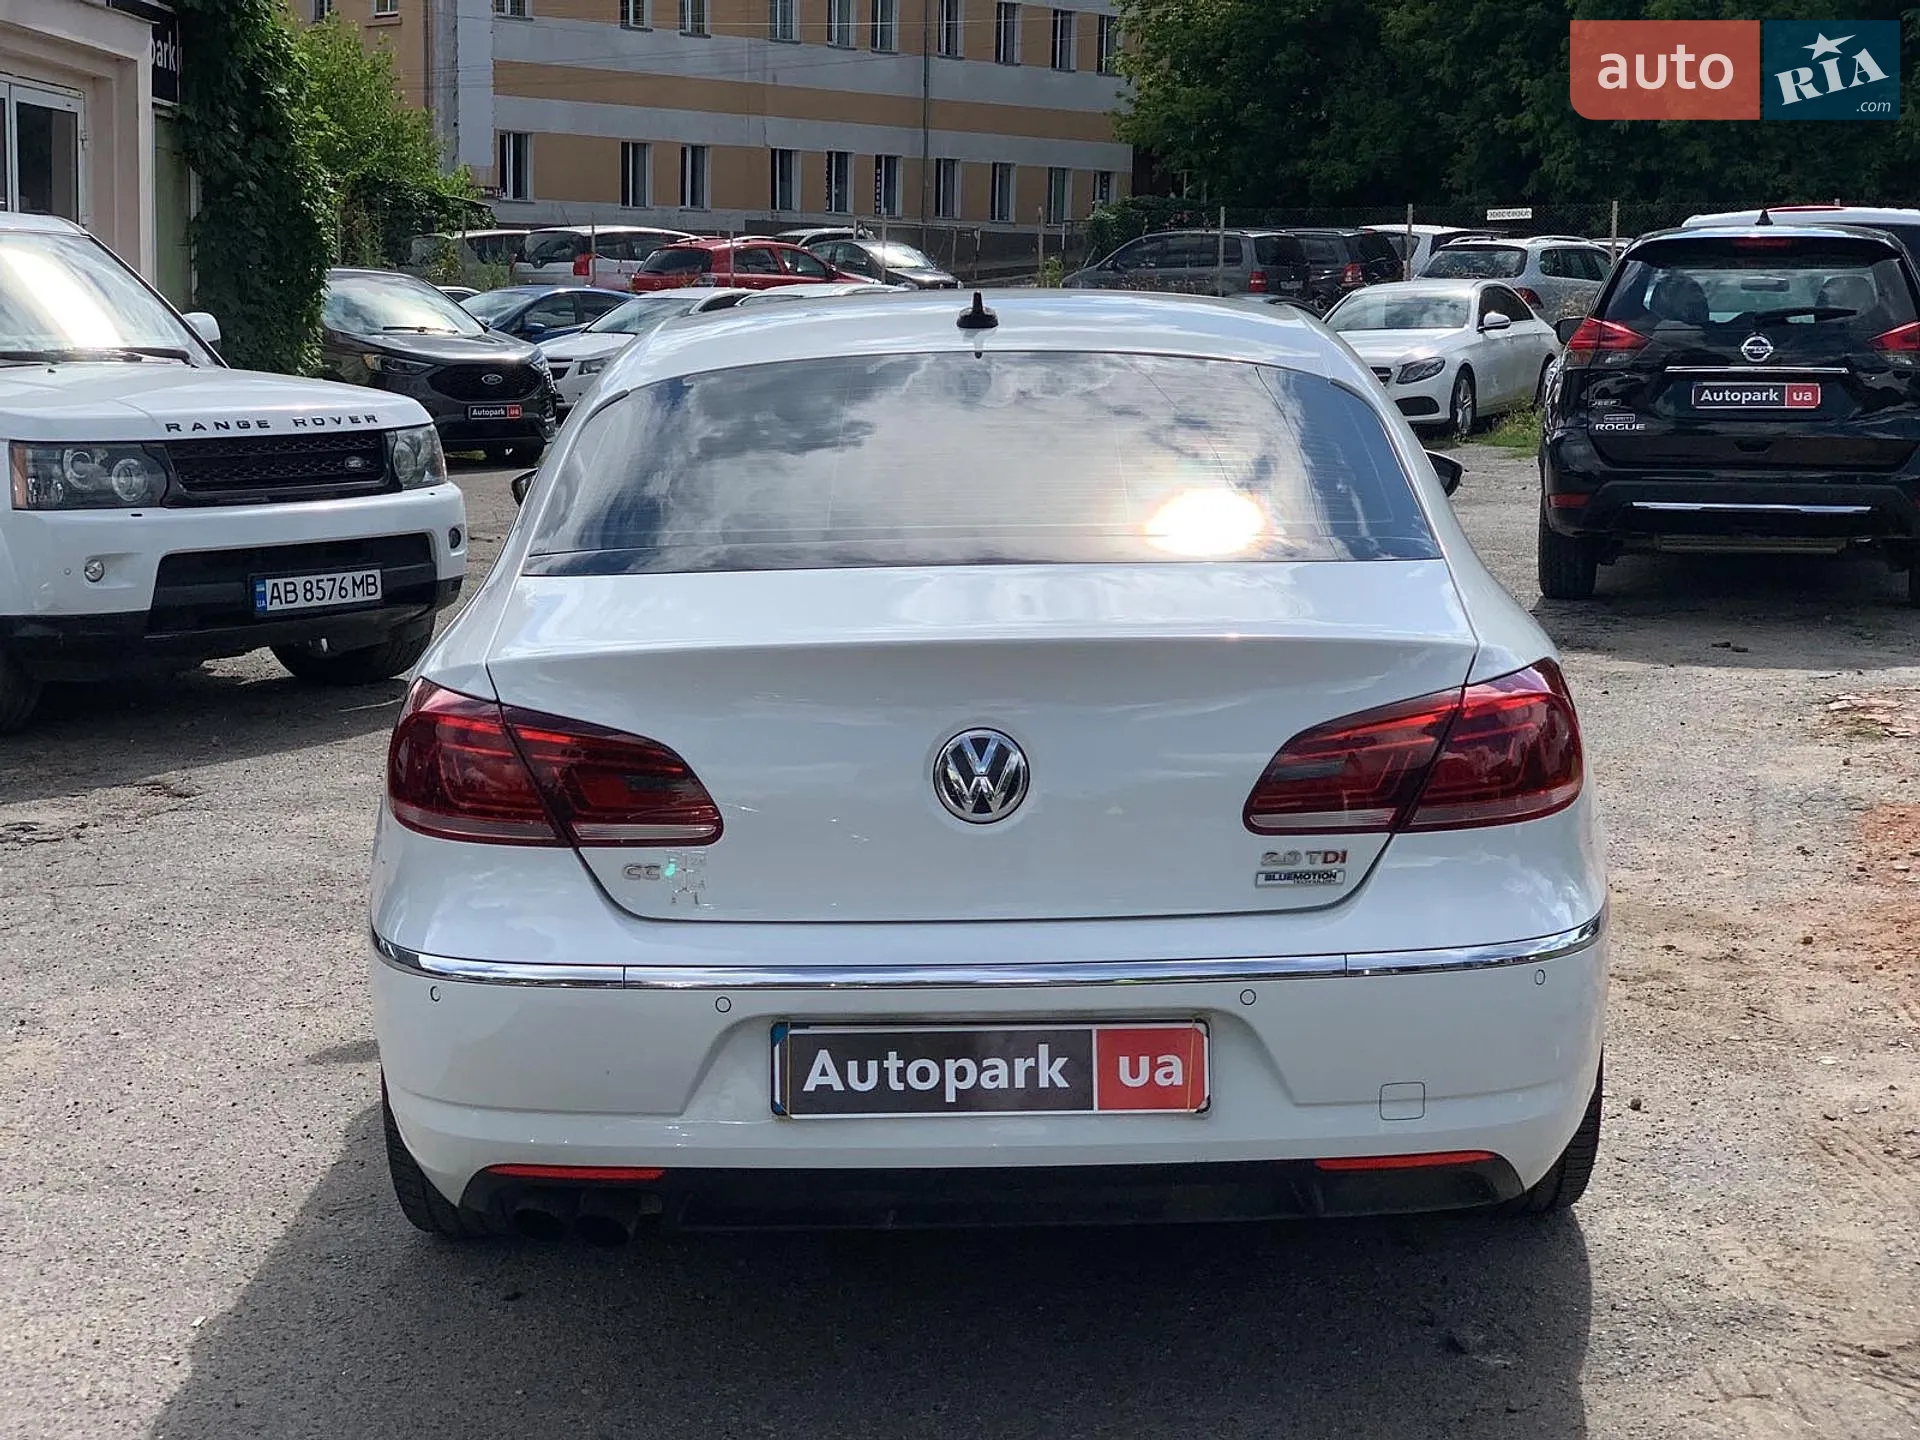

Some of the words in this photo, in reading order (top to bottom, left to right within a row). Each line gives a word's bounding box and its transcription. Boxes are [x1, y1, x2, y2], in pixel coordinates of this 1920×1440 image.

[1700, 388, 1779, 405] Autopark
[1792, 391, 1812, 401] ua
[472, 407, 506, 417] Autopark
[165, 419, 271, 433] RANGE
[292, 414, 379, 428] ROVER
[1595, 423, 1646, 431] ROGUE
[269, 581, 299, 606] AB
[303, 576, 349, 603] 8576
[351, 573, 379, 598] MB
[1305, 849, 1348, 865] TDI
[1264, 871, 1337, 882] BLUEMOTION
[802, 1043, 1071, 1103] Autopark
[1119, 1053, 1183, 1089] ua
